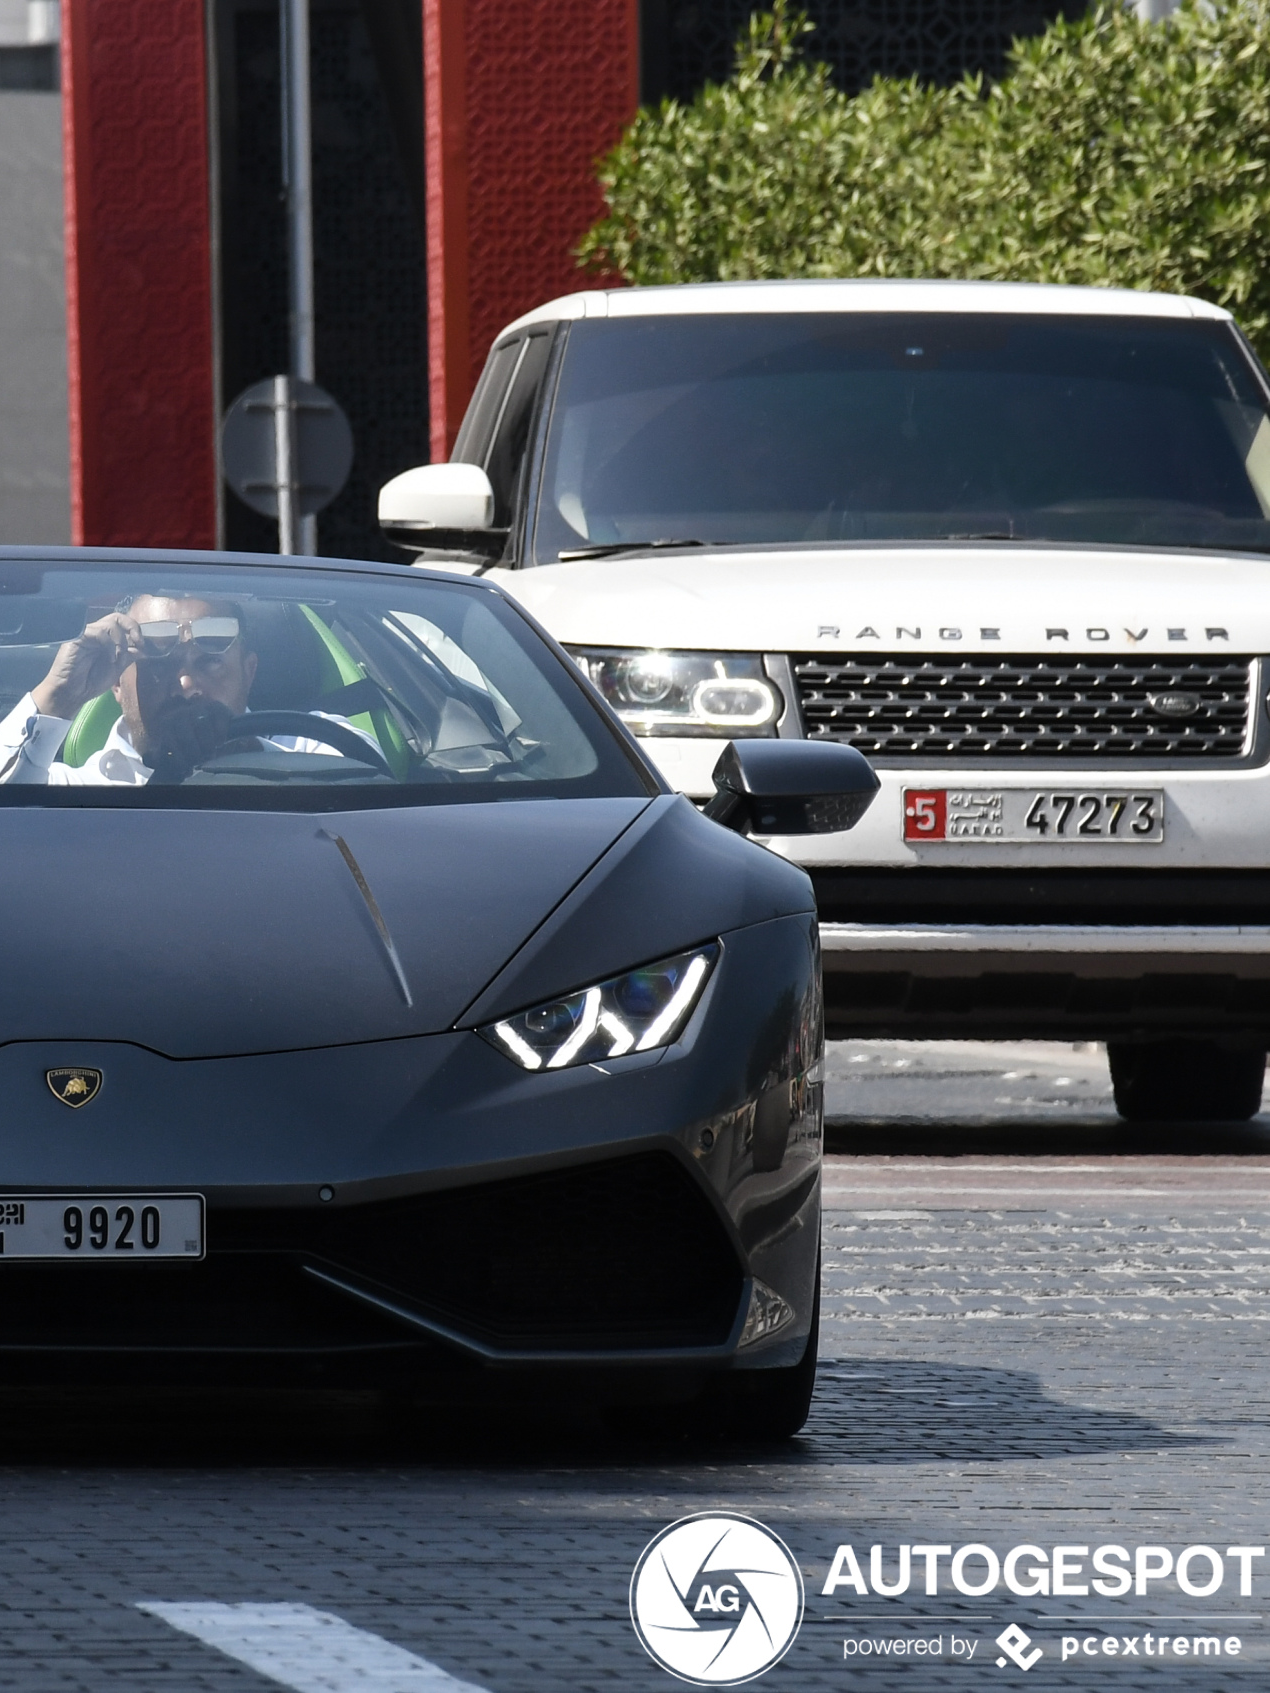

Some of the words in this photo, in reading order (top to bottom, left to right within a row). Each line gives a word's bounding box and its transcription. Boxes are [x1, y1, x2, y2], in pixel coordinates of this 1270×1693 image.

[817, 626, 1002, 641] RANGE
[1045, 626, 1230, 641] ROVER
[914, 797, 937, 832] 5
[1025, 793, 1156, 835] 47273
[62, 1204, 161, 1250] 9920
